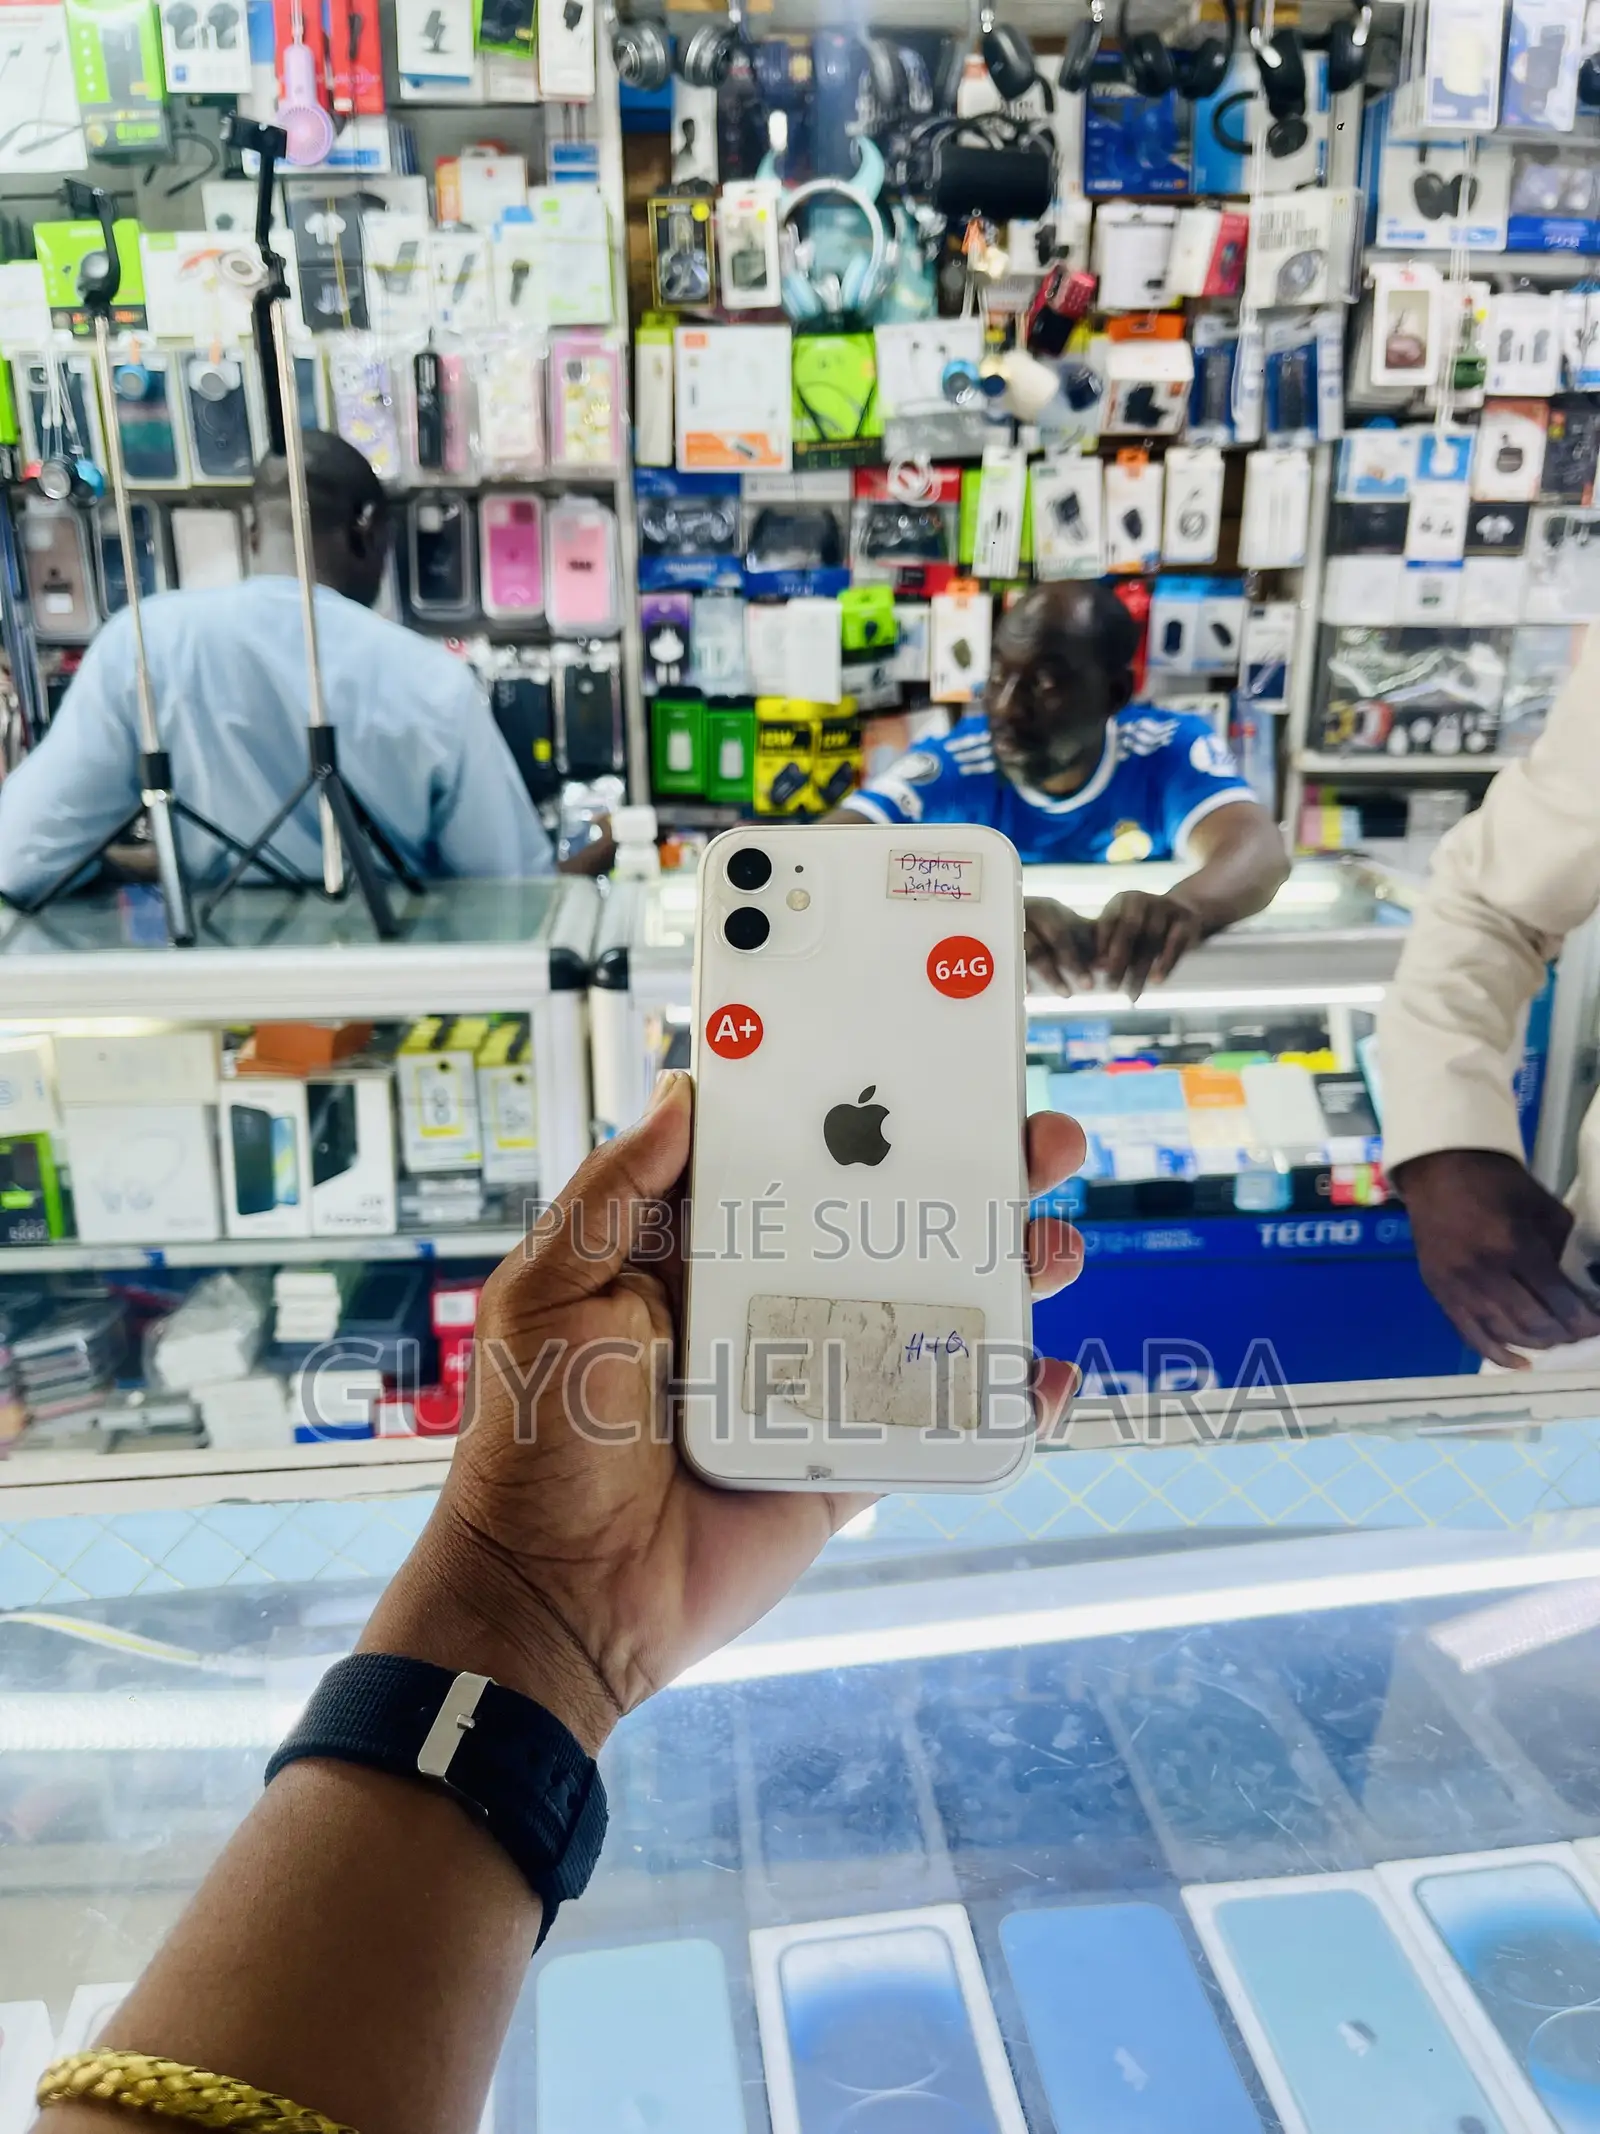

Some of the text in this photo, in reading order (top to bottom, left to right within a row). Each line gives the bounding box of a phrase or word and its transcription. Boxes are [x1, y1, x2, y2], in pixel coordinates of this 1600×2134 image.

[901, 853, 962, 879] Display
[935, 956, 988, 981] 64G
[714, 1014, 758, 1043] A+
[1258, 1220, 1361, 1248] TECNO
